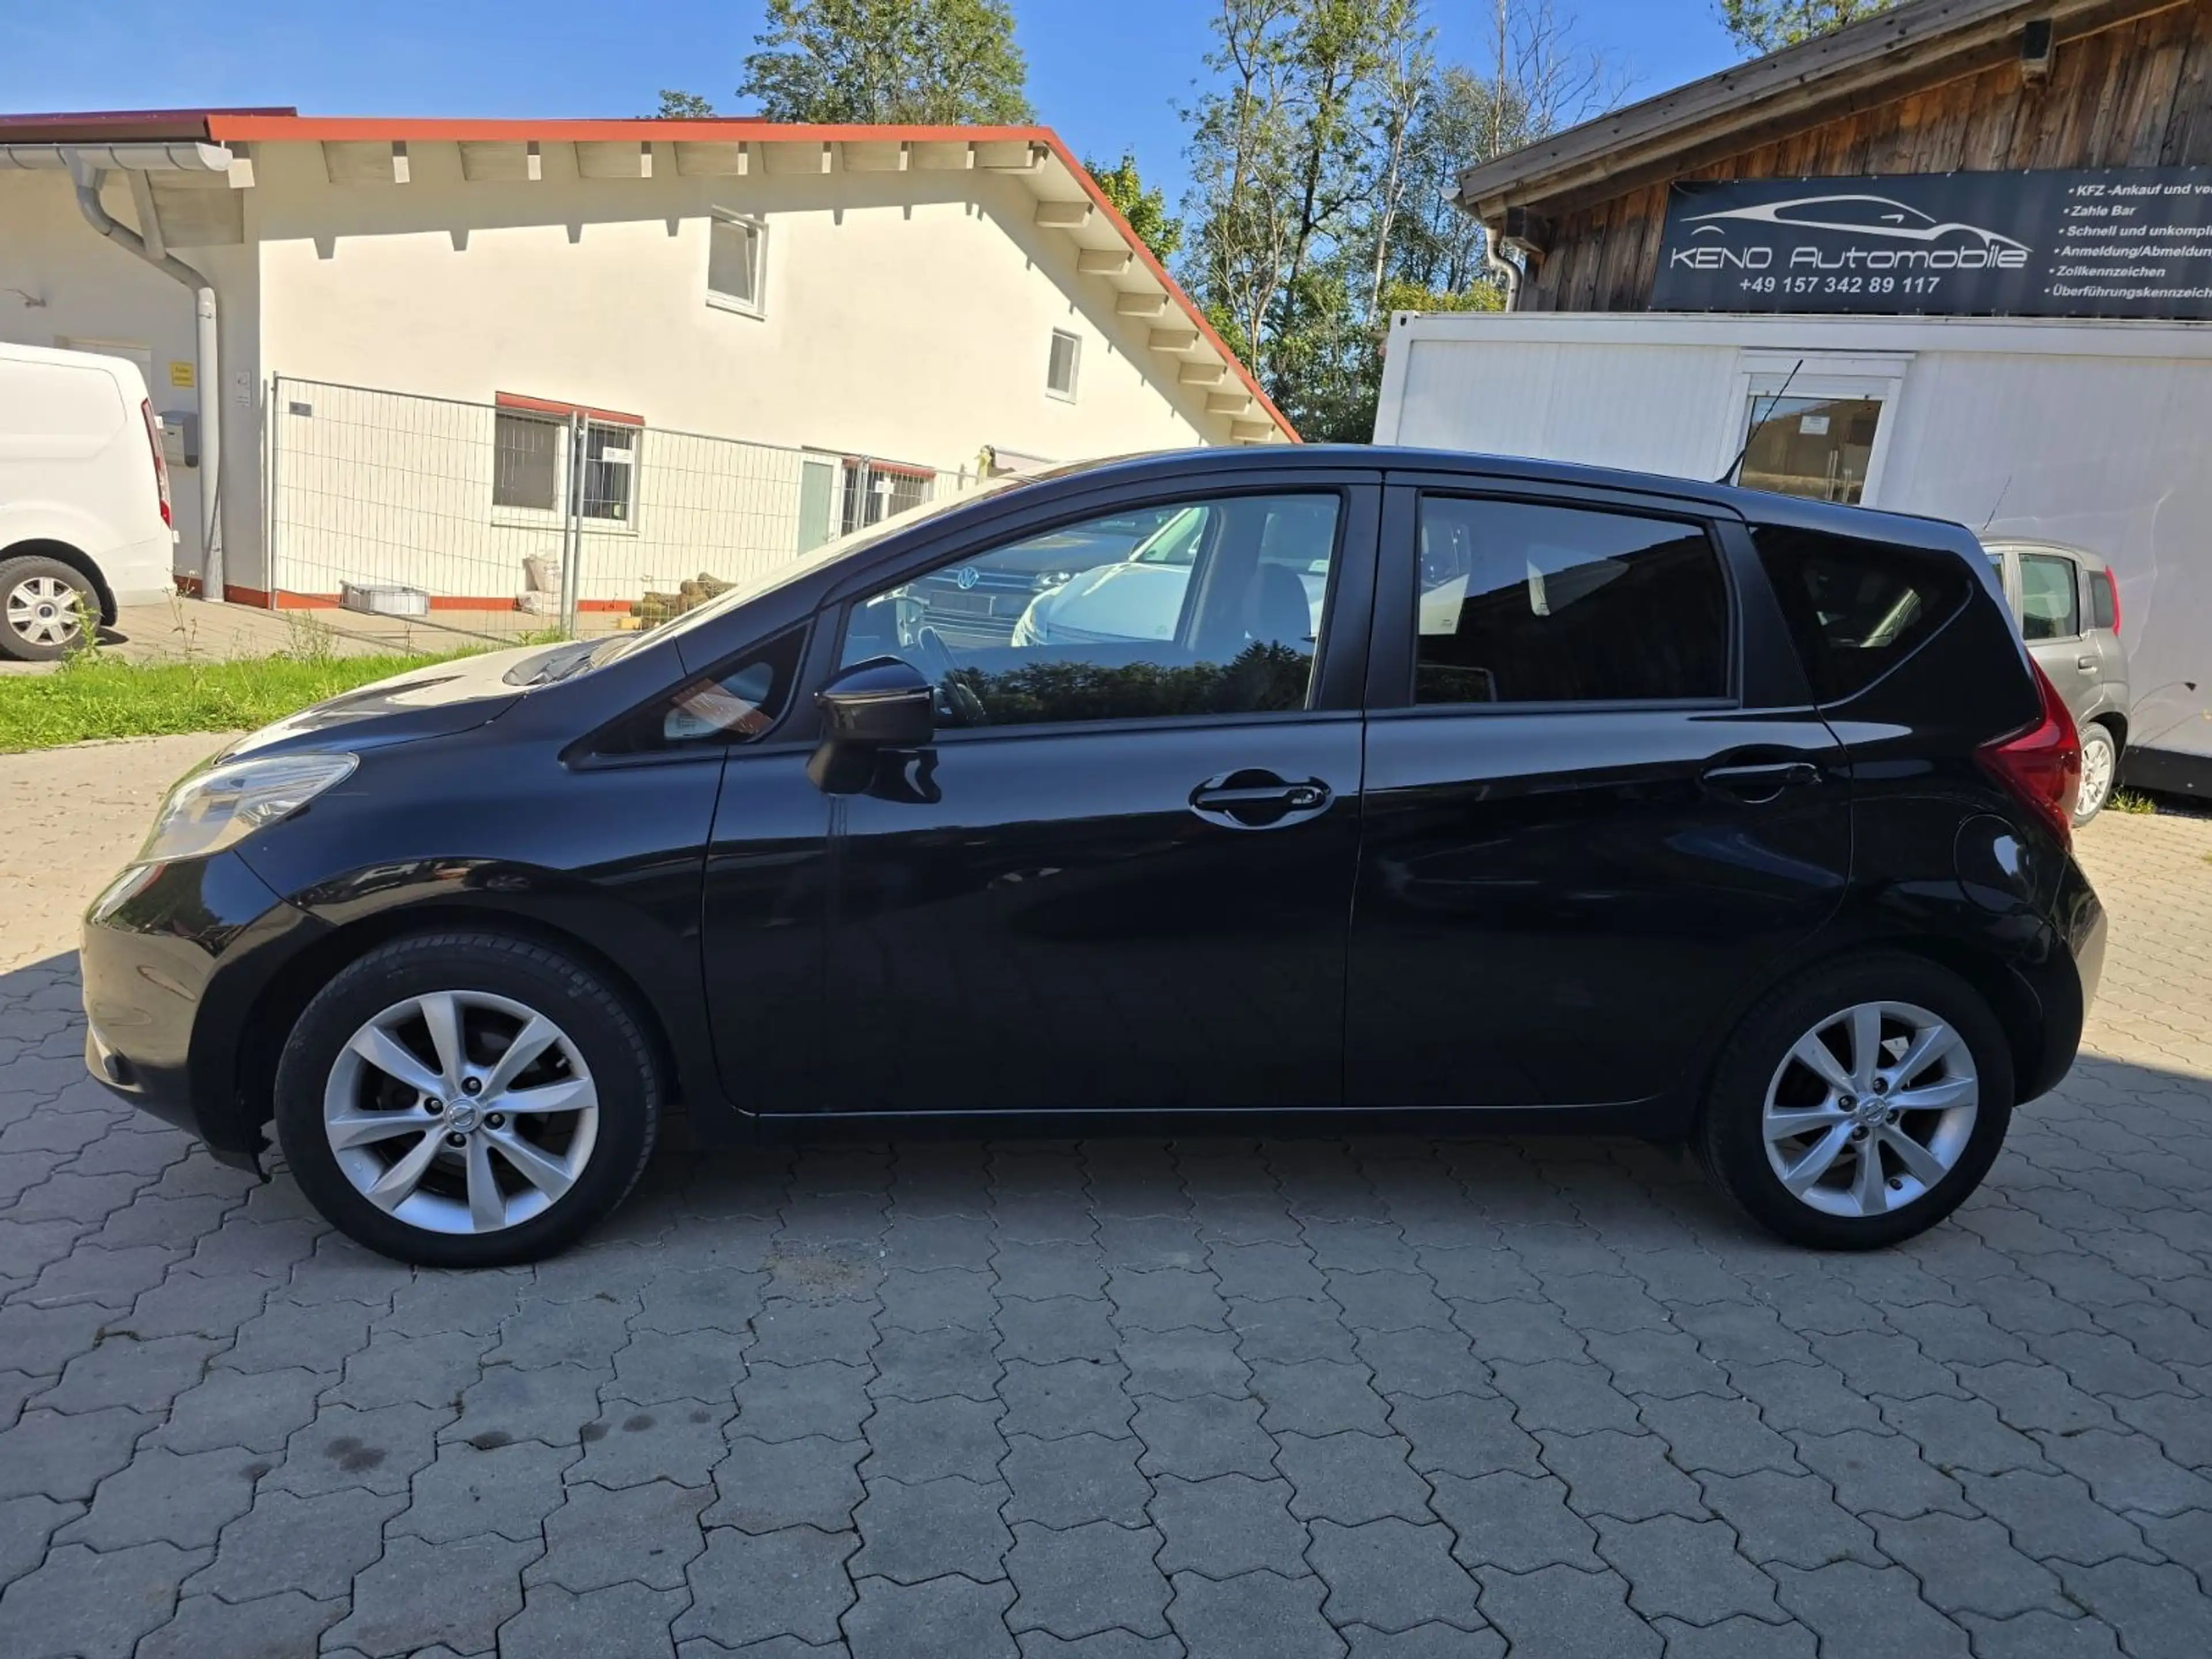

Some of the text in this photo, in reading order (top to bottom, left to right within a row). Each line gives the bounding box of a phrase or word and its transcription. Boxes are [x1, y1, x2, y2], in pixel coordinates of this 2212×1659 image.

[2076, 184, 2106, 196] KFZ
[2163, 183, 2192, 195] und
[2071, 204, 2138, 217] Zahle Bar
[2066, 225, 2117, 237] Schnell
[2119, 225, 2147, 236] und
[1670, 244, 2028, 269] KENO Automobile
[2061, 245, 2212, 259] Anmeldung/Abmeldun
[2056, 265, 2166, 278] Zollkennzeichen
[1740, 276, 1941, 294] +49 157 342 89 117
